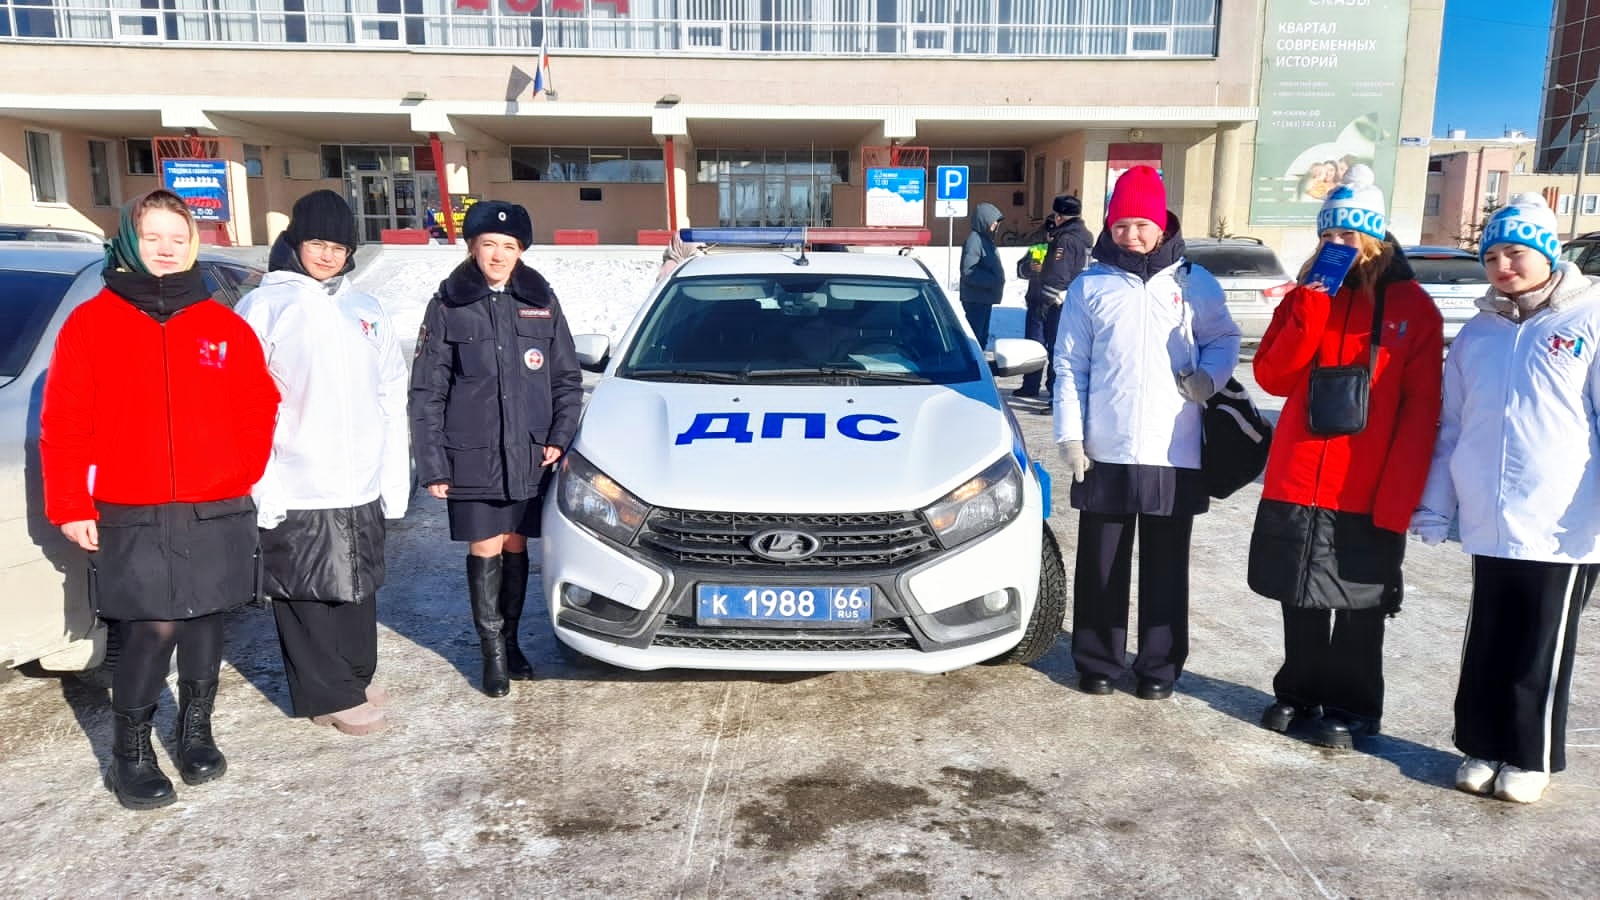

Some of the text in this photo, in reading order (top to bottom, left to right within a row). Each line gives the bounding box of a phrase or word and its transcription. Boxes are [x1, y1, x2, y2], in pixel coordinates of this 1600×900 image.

[1278, 22, 1337, 34] КВАРТАЛ
[1276, 39, 1377, 51] СОВРЕМЕННЫХ
[1276, 54, 1338, 68] ИСТОРИЙ
[945, 170, 962, 197] P
[675, 412, 901, 445] ДПС
[743, 589, 815, 617] 1988
[834, 588, 863, 609] 66
[838, 610, 859, 618] RUS
